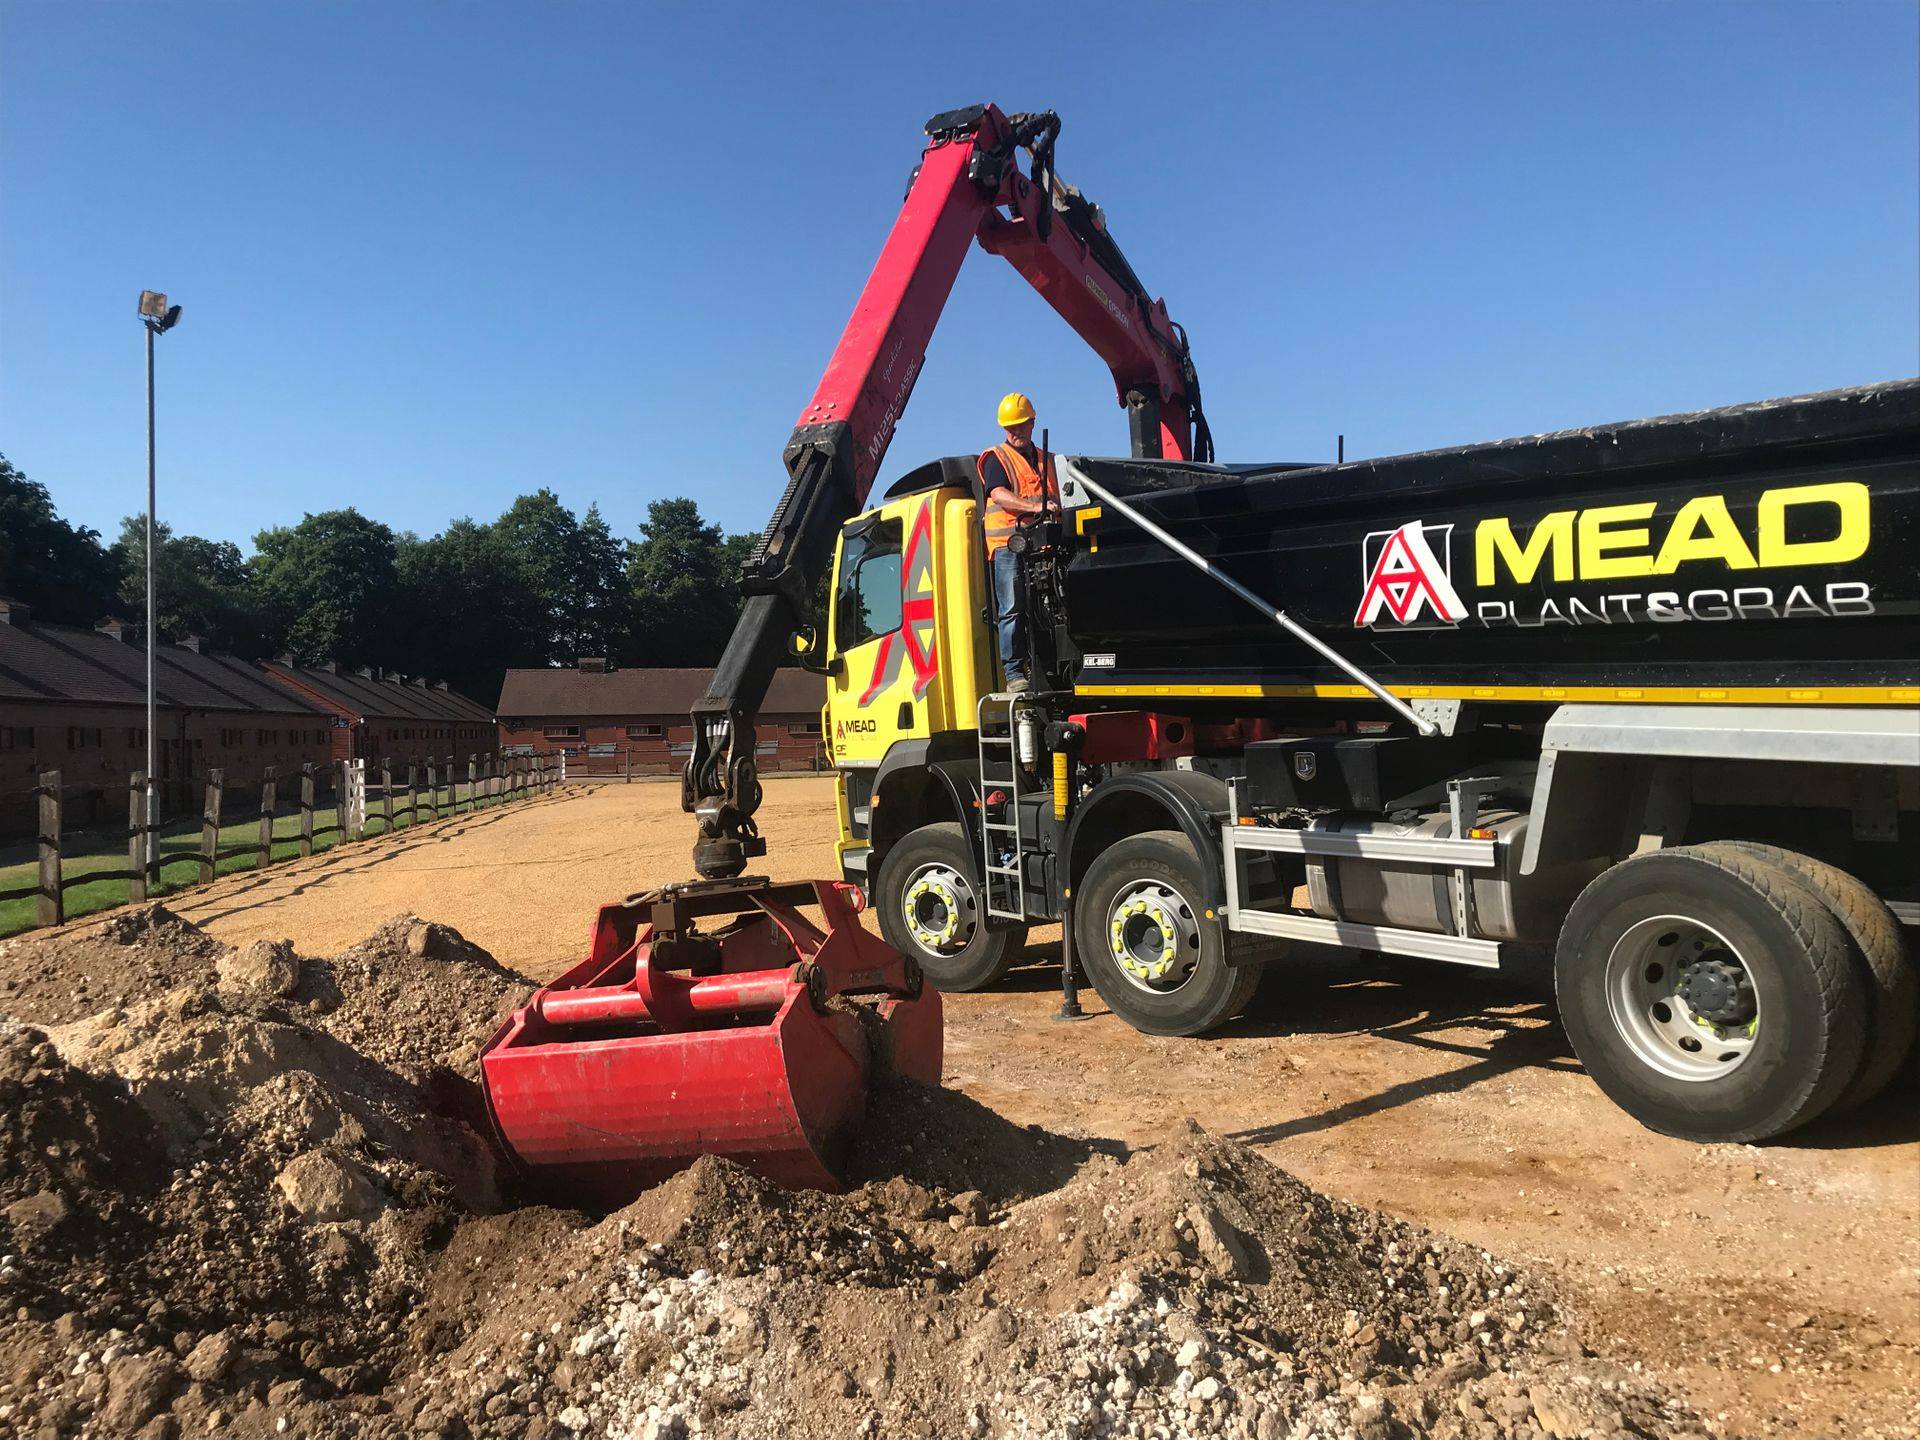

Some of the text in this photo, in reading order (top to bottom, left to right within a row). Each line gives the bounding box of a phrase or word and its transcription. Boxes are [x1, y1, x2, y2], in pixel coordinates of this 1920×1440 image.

[1475, 481, 1871, 587] MEAD
[1477, 581, 1876, 629] PLANT&GRAB
[845, 719, 877, 733] MEAD
